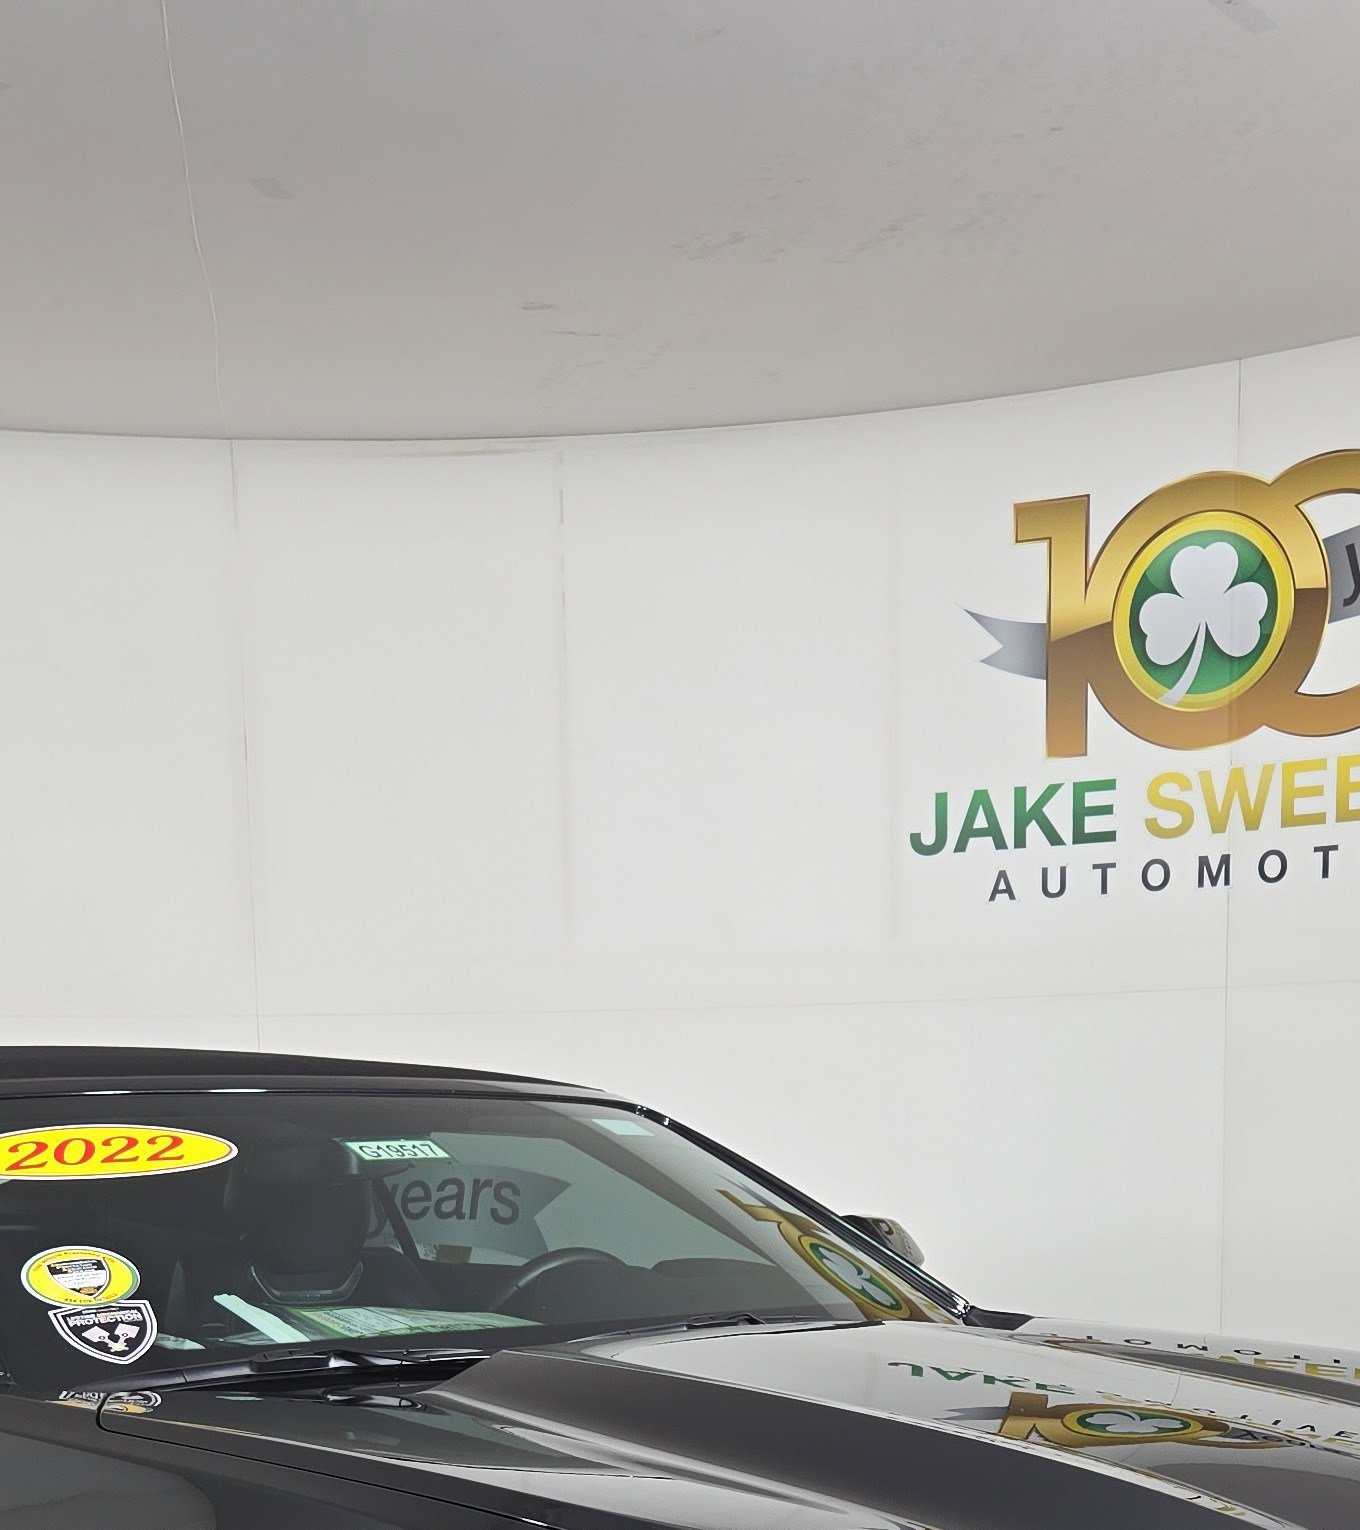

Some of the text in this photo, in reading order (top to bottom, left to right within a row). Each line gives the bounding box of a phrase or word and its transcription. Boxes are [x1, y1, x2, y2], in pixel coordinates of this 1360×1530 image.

[909, 778, 1116, 856] JAKE
[5, 1135, 185, 1171] 2022
[359, 1143, 440, 1158] G19517
